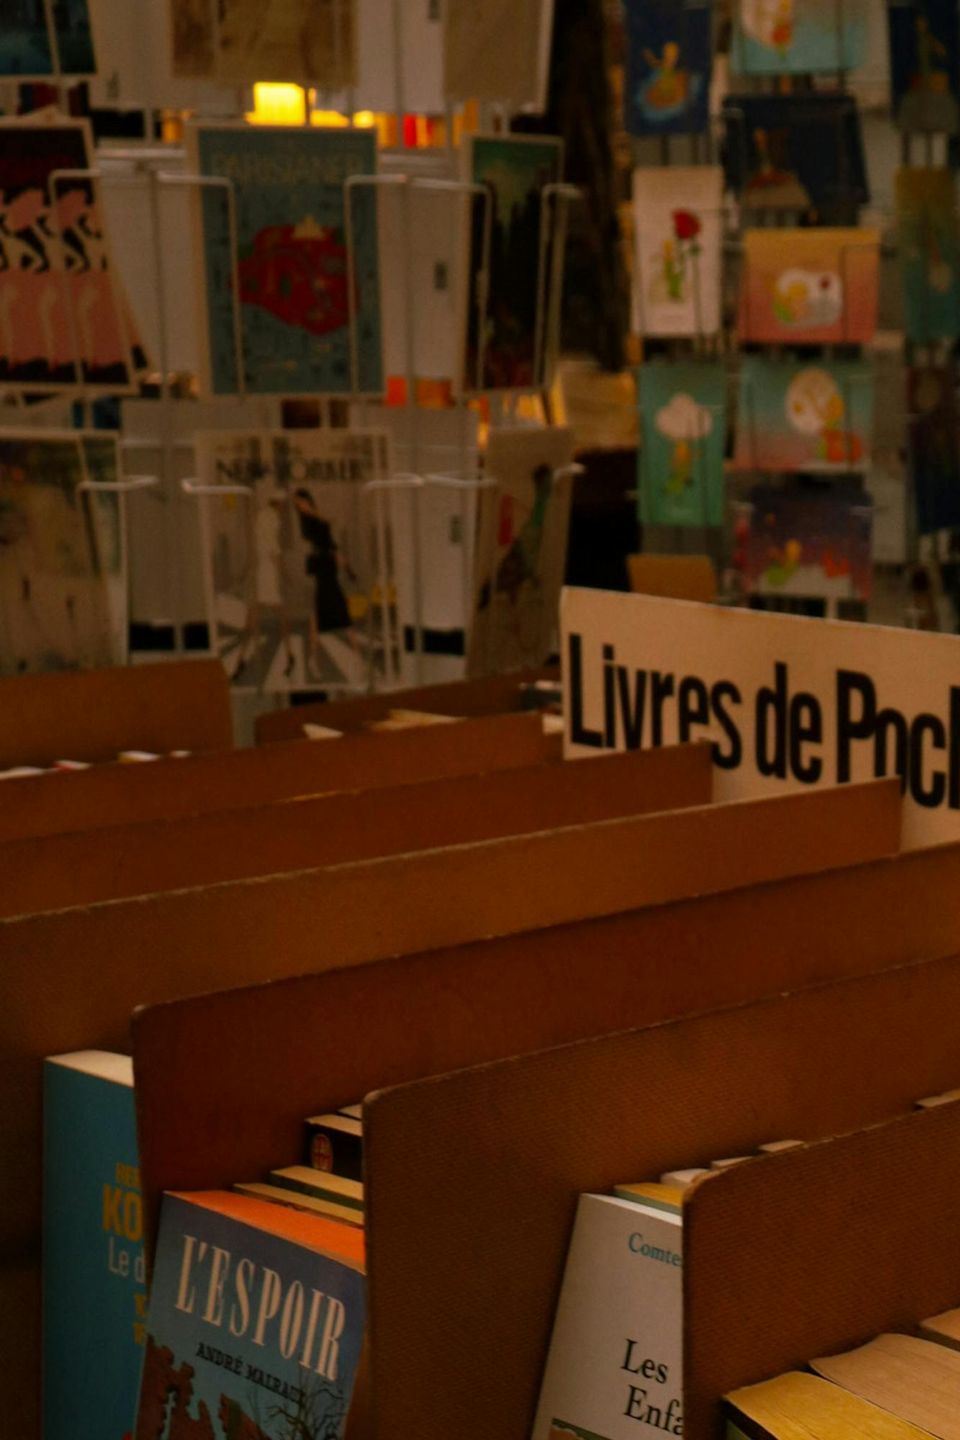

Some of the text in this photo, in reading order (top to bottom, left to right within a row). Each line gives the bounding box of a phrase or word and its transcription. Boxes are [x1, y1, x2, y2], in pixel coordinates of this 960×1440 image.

[569, 633, 742, 770] Livres
[756, 661, 822, 783] de
[108, 1235, 130, 1279] Le
[175, 1234, 346, 1382] L'ESPOIR
[196, 1342, 243, 1375] ANDRÉ
[620, 1338, 668, 1384] Les
[624, 1384, 684, 1436] Enfa
